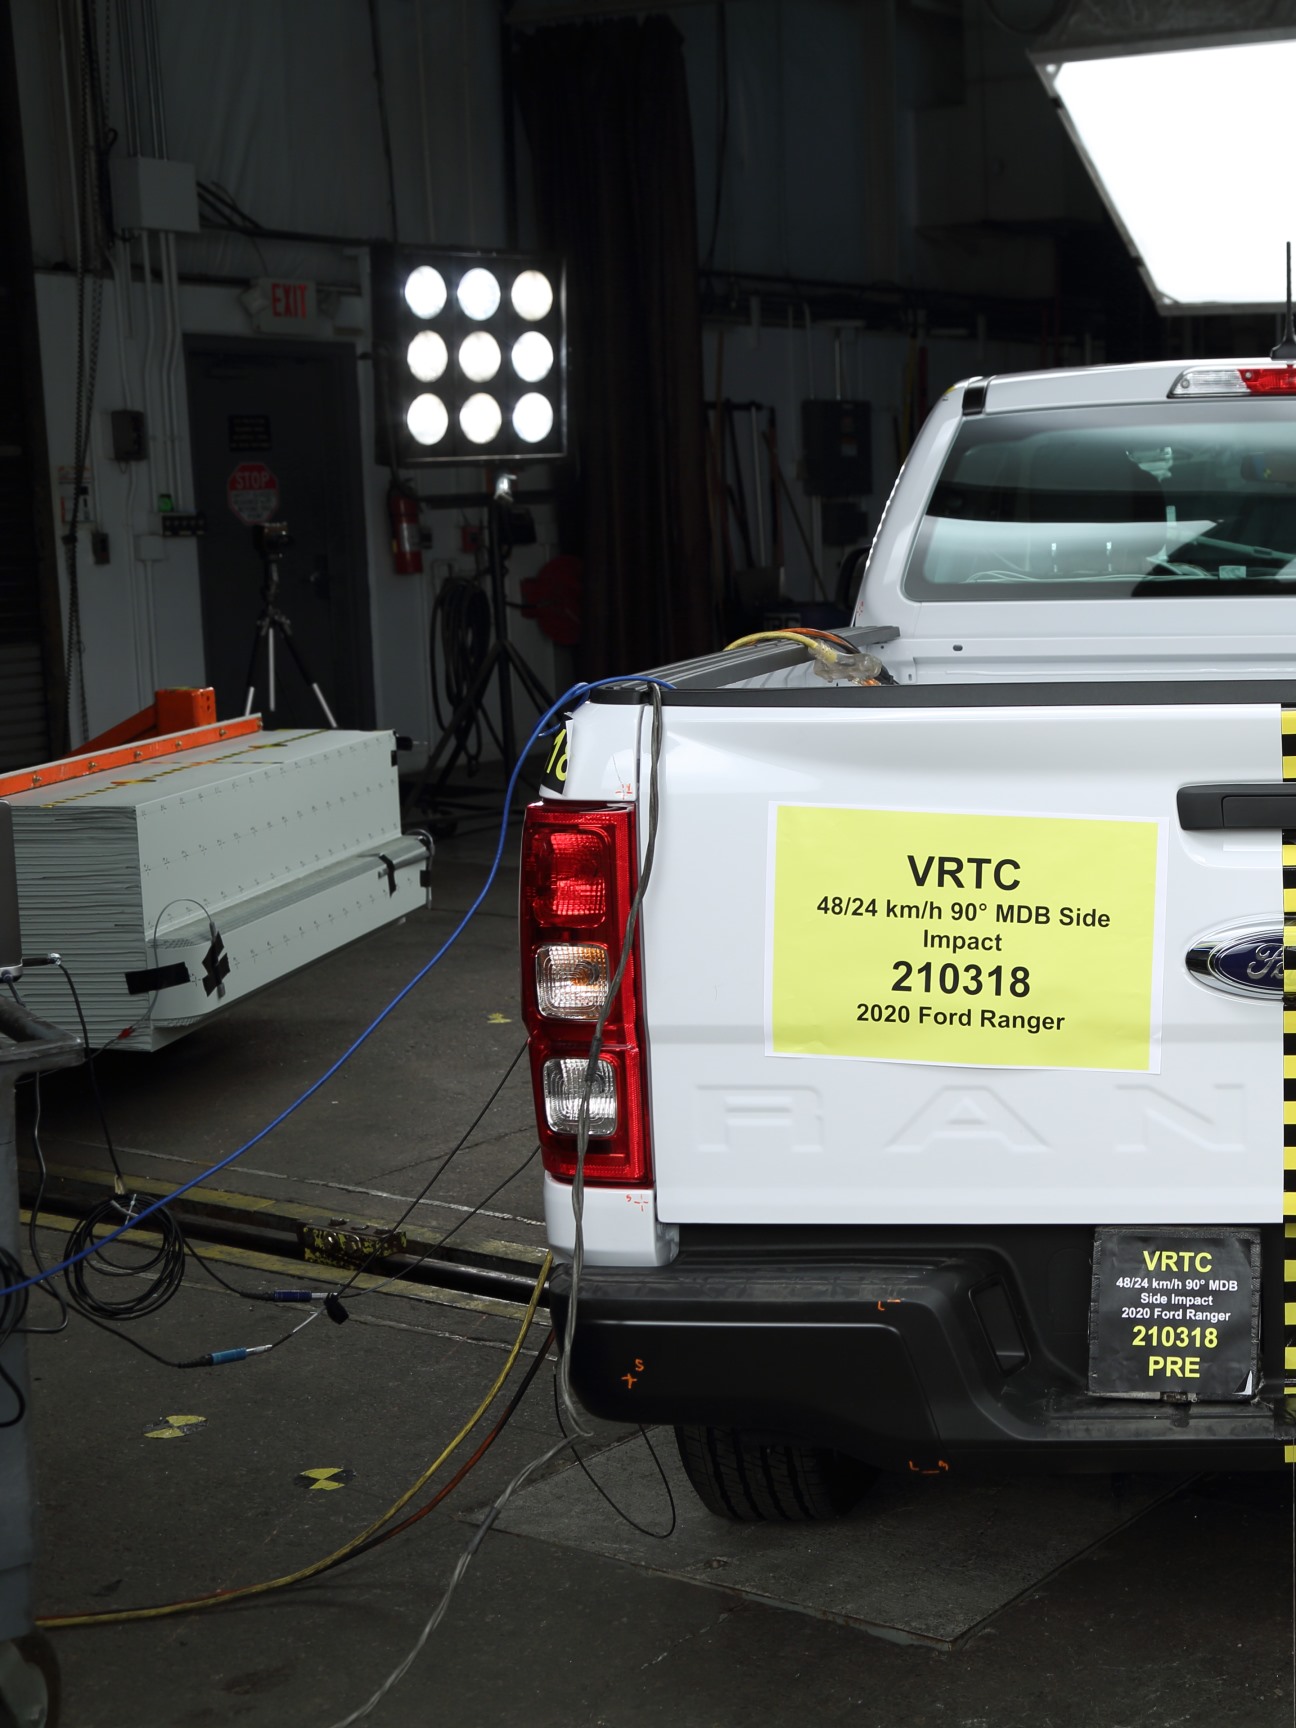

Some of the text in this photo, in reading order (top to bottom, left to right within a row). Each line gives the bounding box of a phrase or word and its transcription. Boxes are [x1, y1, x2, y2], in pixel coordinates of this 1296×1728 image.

[272, 284, 307, 319] EXIT
[235, 471, 270, 489] STOP
[907, 855, 1021, 891] VRTC
[816, 896, 1111, 928] 48/24 km/h 90° MDB Side
[923, 930, 1003, 954] Impact
[891, 961, 1030, 998] 210318
[856, 1004, 1066, 1034] 2020 Ford Ranger
[1143, 1251, 1213, 1273] VRTC
[1116, 1277, 1149, 1289] 48/24
[1152, 1278, 1182, 1290] km/h
[1209, 1280, 1238, 1291] MDB
[1141, 1293, 1213, 1307] Side Impact
[1122, 1307, 1231, 1323] 2020 Ford Ranger
[1132, 1325, 1218, 1349] 210318
[1148, 1356, 1201, 1378] PRE
